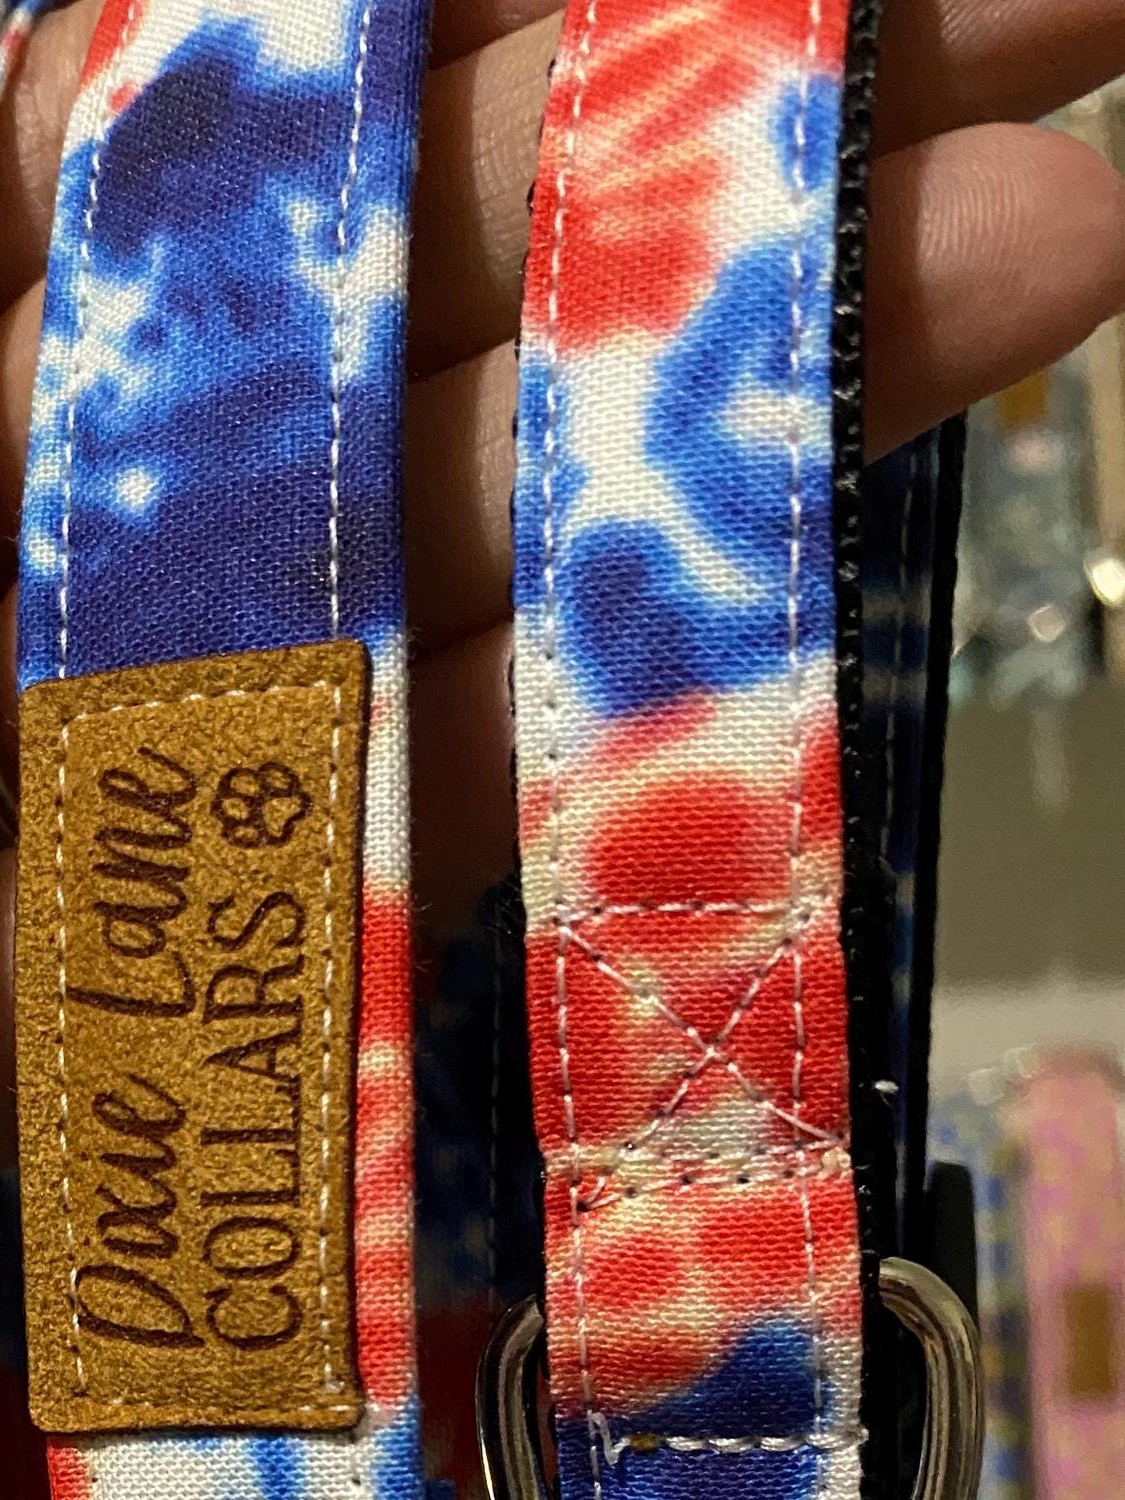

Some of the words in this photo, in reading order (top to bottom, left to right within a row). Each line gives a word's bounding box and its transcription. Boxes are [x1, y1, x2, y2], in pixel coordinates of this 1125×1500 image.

[66, 745, 199, 1020] Lane
[75, 1072, 205, 1347] Dixie
[198, 889, 306, 1351] COLLARS
